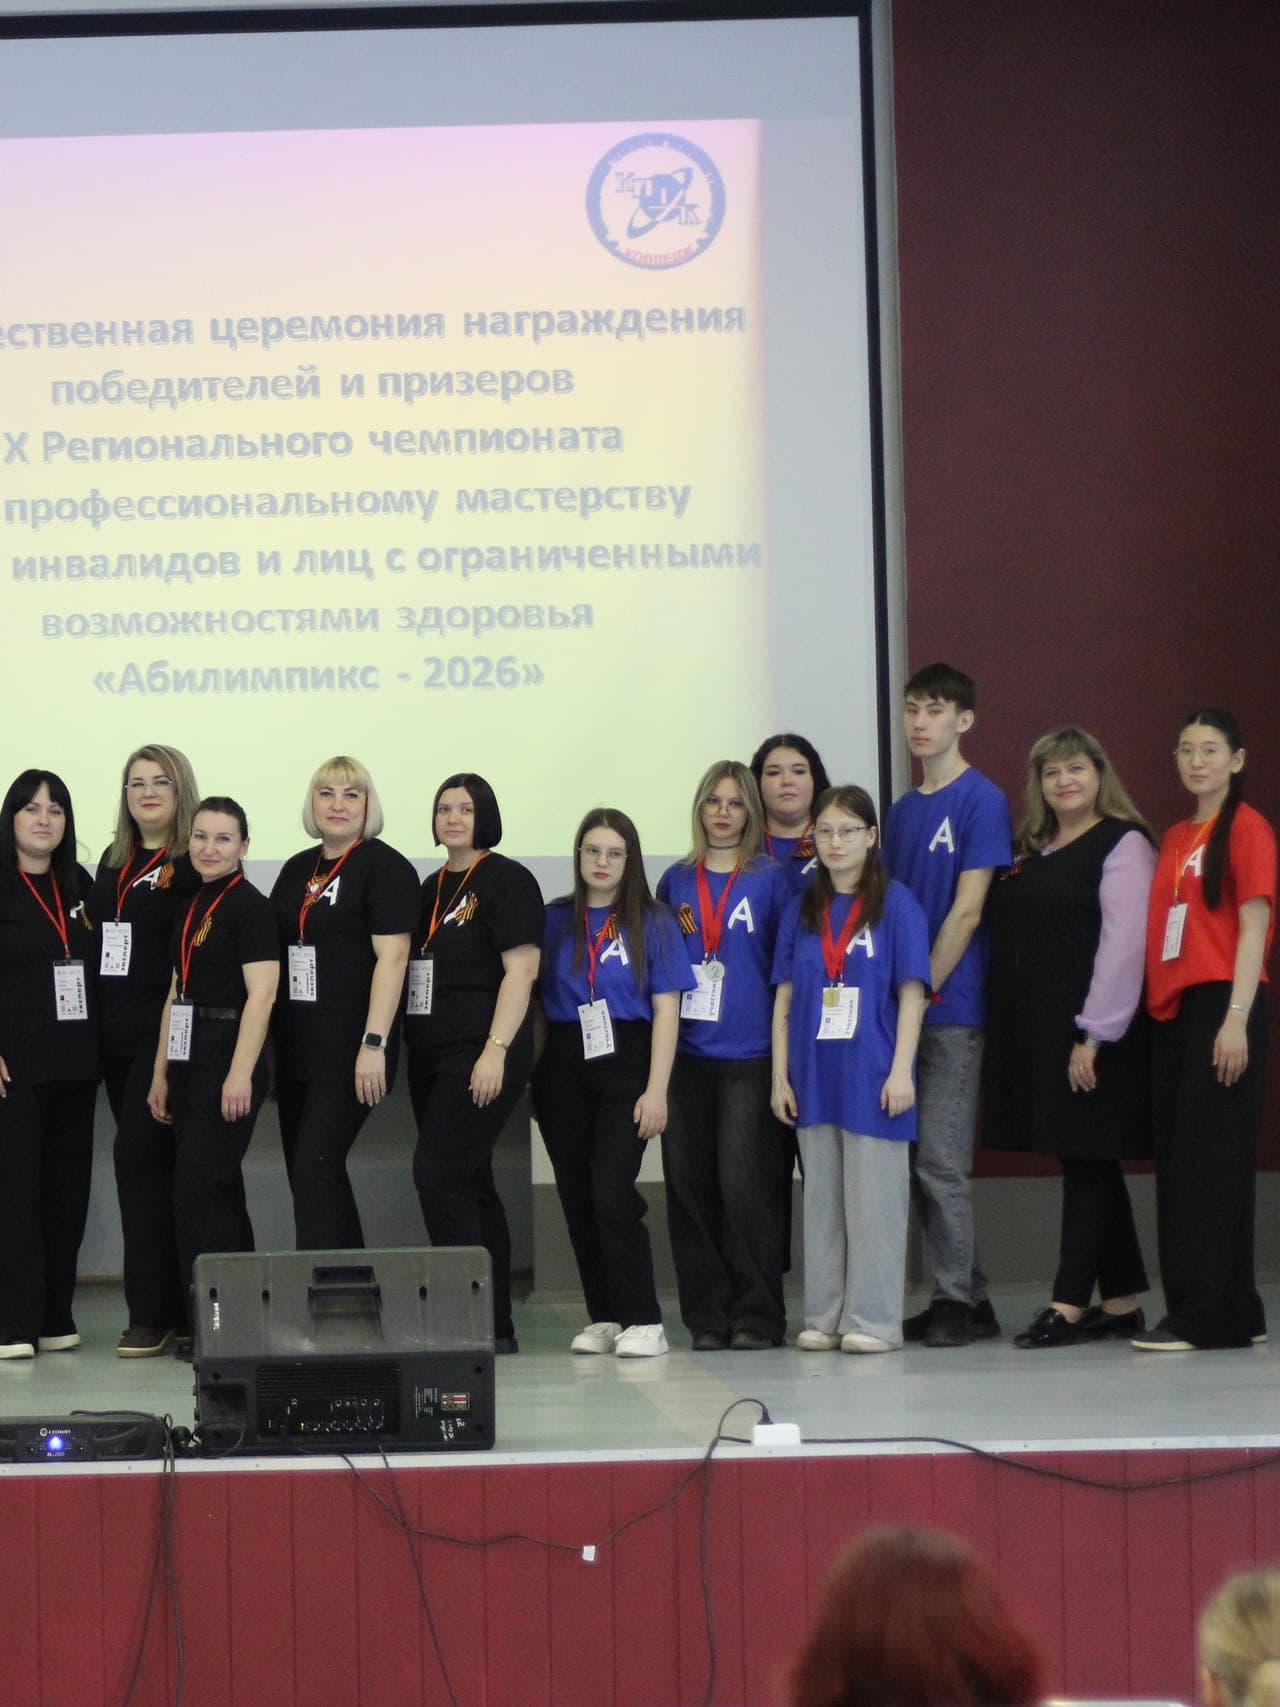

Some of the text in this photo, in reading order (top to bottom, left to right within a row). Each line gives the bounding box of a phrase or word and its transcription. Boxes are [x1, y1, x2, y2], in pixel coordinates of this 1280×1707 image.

[209, 312, 446, 351] церемония
[463, 307, 746, 345] награждения
[51, 365, 576, 409] победителей и призеров
[42, 431, 353, 464] Регионального
[368, 425, 624, 456] чемпионата
[4, 489, 439, 531] профессиональному
[456, 484, 693, 521] мастерству
[12, 551, 241, 586] инвалидов
[257, 550, 282, 576] и
[292, 549, 375, 582] лиц
[385, 548, 407, 574] с
[417, 543, 760, 581] ограниченными
[42, 604, 594, 640] возможностями здоровья
[93, 659, 380, 696] «Абилимпикс
[424, 655, 544, 690] 2026»
[708, 980, 718, 1017] участни
